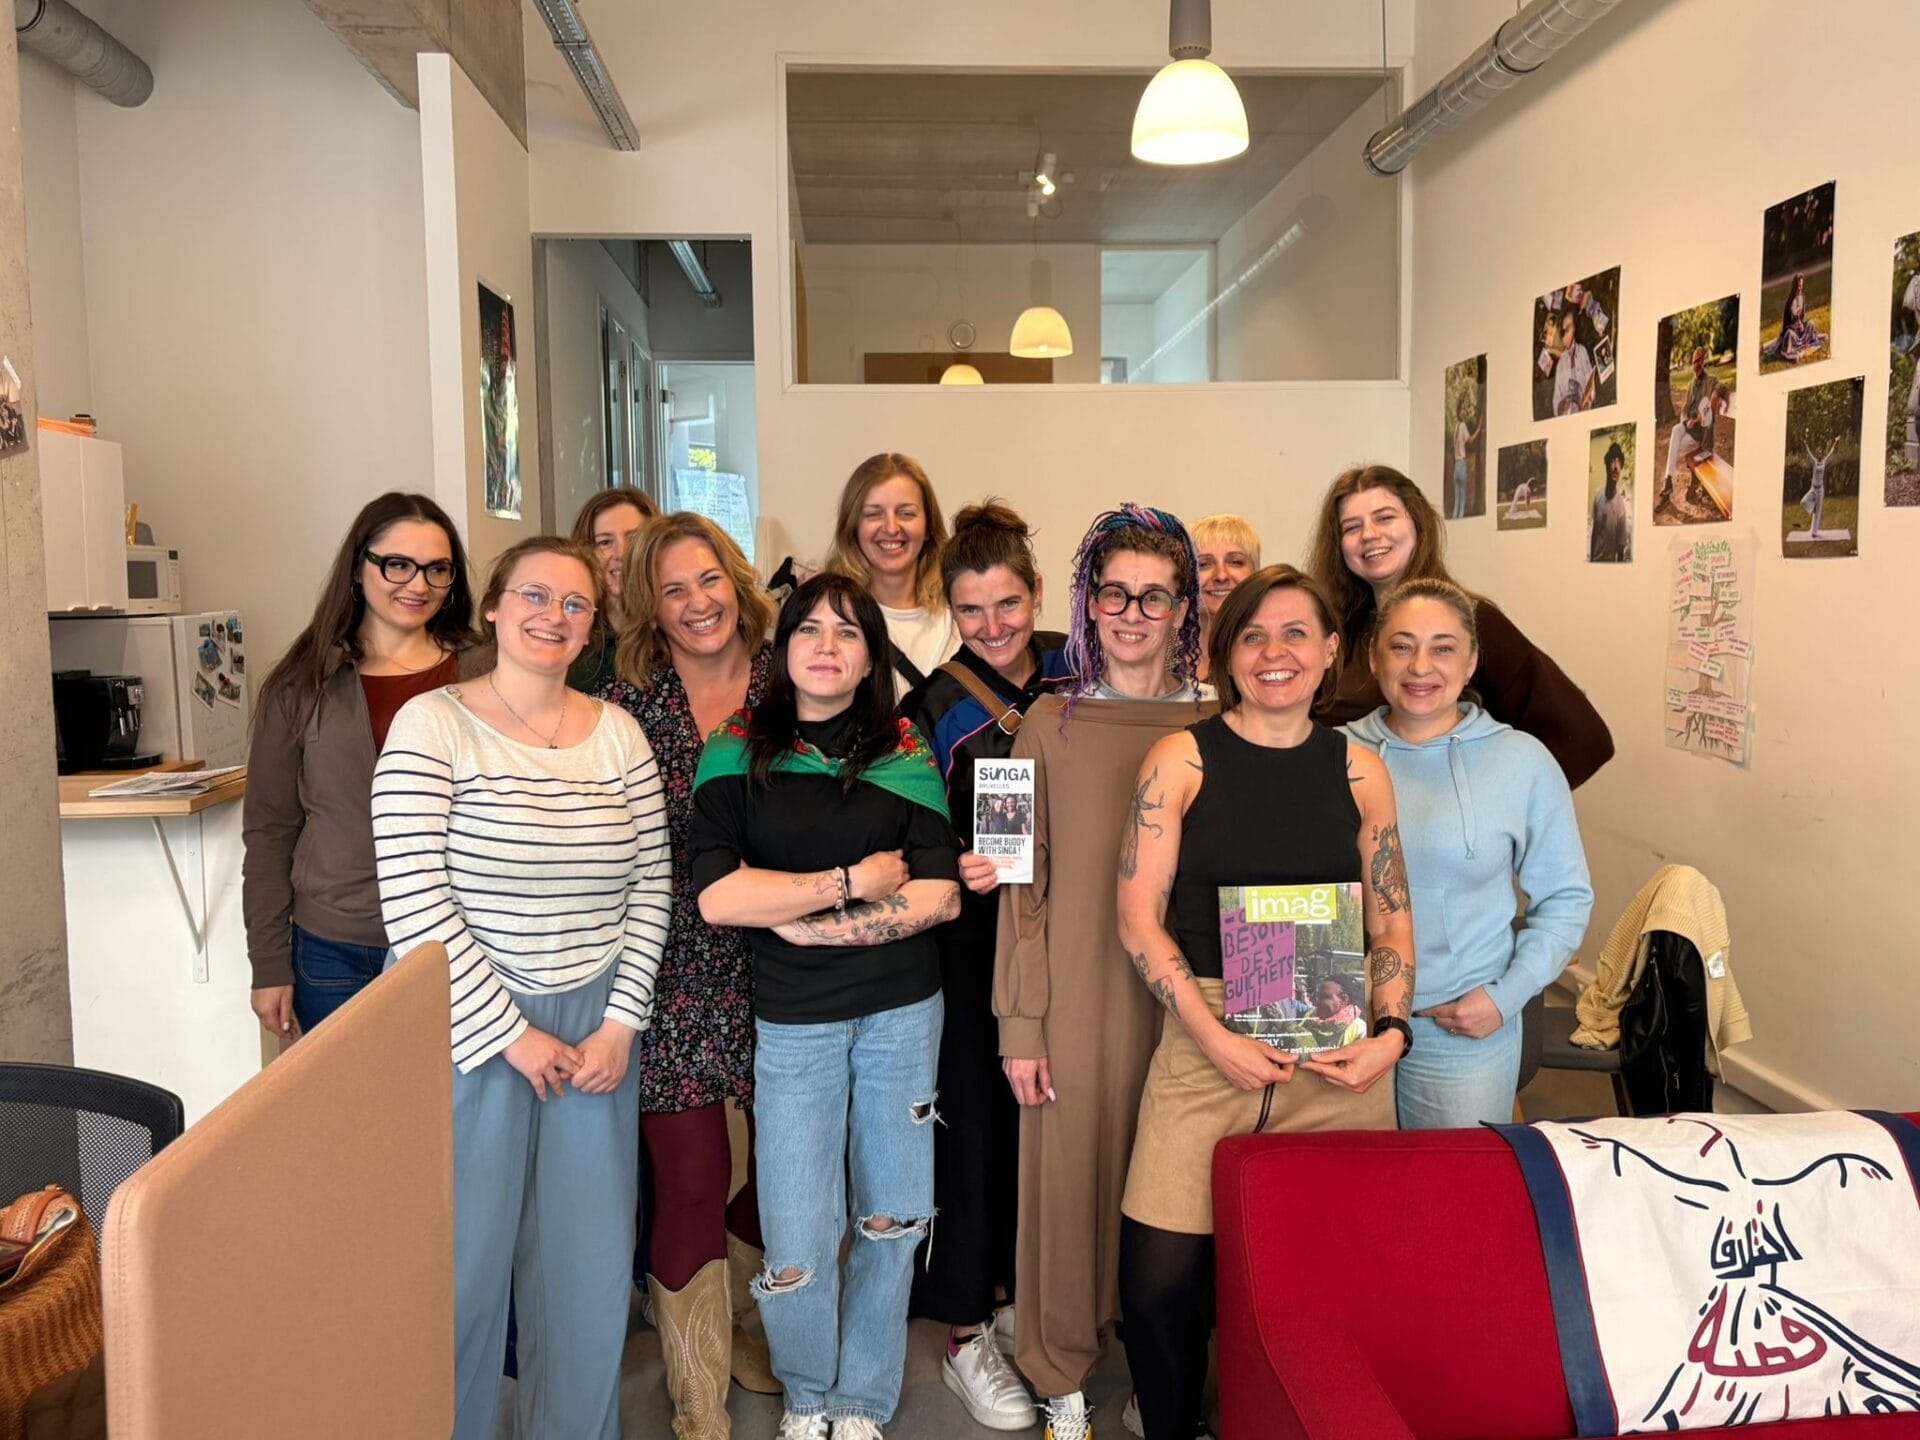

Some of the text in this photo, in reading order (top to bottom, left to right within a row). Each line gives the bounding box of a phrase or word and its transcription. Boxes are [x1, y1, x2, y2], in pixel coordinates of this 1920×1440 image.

[978, 837, 1026, 846] BECOME BUDDY
[978, 846, 997, 854] WITH
[998, 847, 1017, 855] SINGA
[1251, 889, 1331, 919] imag
[1241, 943, 1274, 974] DES
[1224, 955, 1294, 1000] GUICHETS
